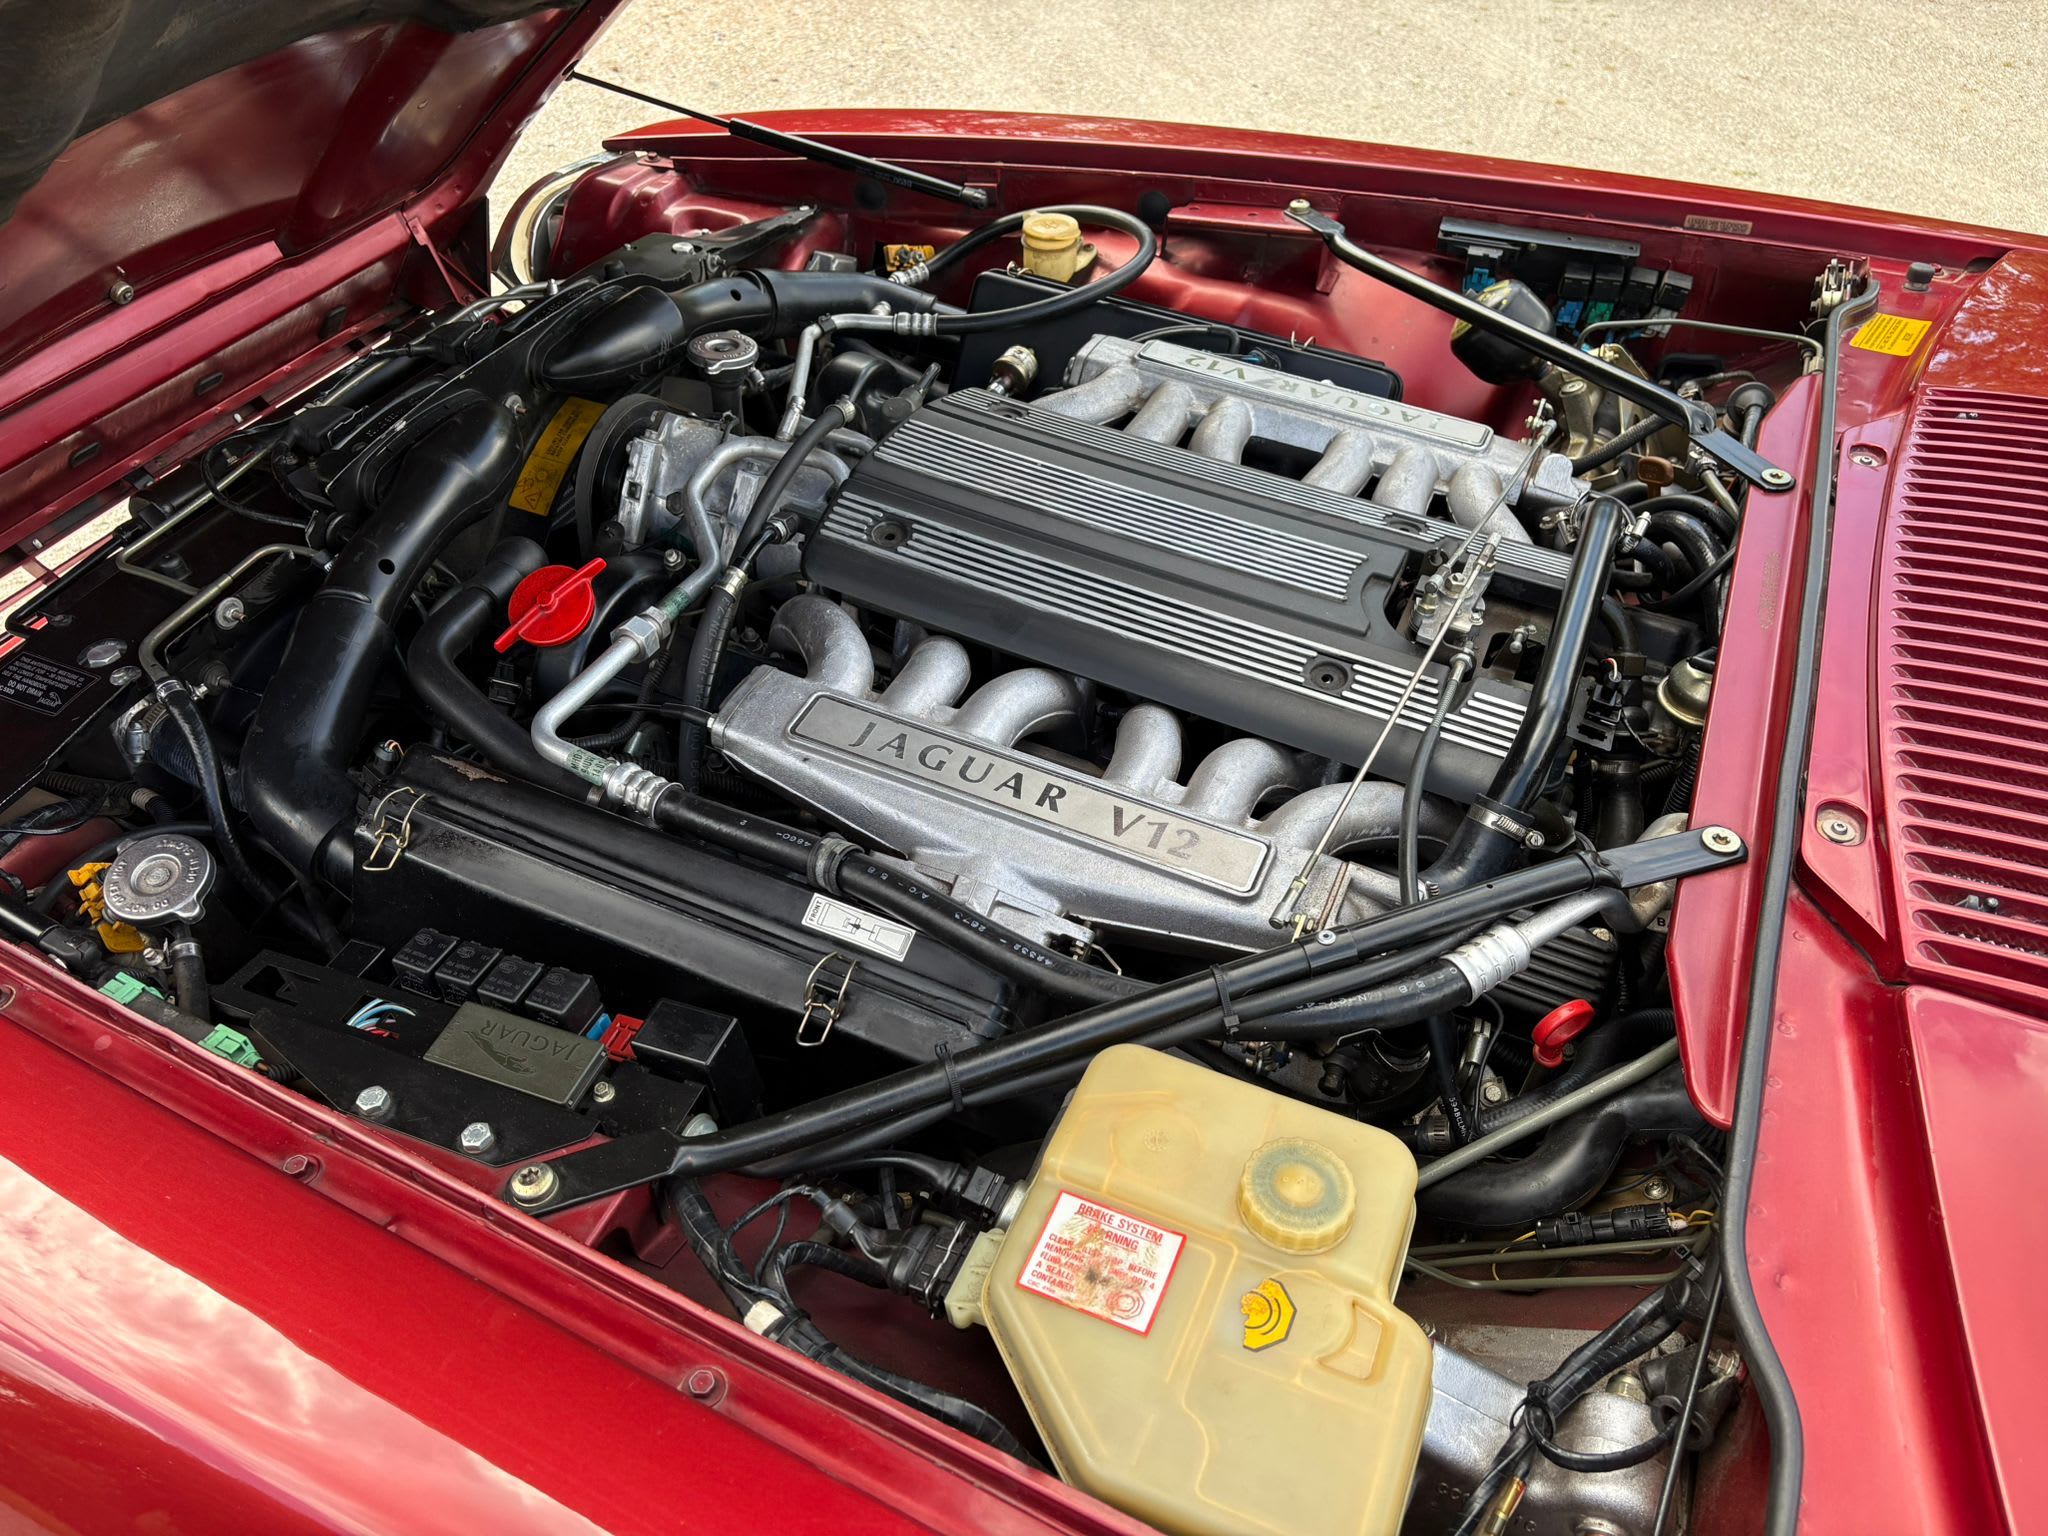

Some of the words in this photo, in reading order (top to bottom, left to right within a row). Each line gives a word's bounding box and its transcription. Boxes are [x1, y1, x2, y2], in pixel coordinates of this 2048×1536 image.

[1184, 354, 1246, 381] V12
[1277, 378, 1442, 430] JAGUAR
[7, 679, 17, 688] DO
[16, 682, 28, 692] NOT
[25, 687, 44, 697] DRAIN
[848, 721, 1067, 814] JAGUAR
[1111, 805, 1201, 860] V12
[808, 900, 822, 922] FRONT
[480, 1019, 582, 1061] JAGUAR
[1076, 1203, 1114, 1226] BRAKE
[1118, 1218, 1164, 1243] SYSTEM
[1035, 1261, 1042, 1269] A
[1049, 1233, 1074, 1247] CLEAN
[1128, 1263, 1158, 1280] BEFORE
[1030, 1270, 1075, 1293] CONTAINER
